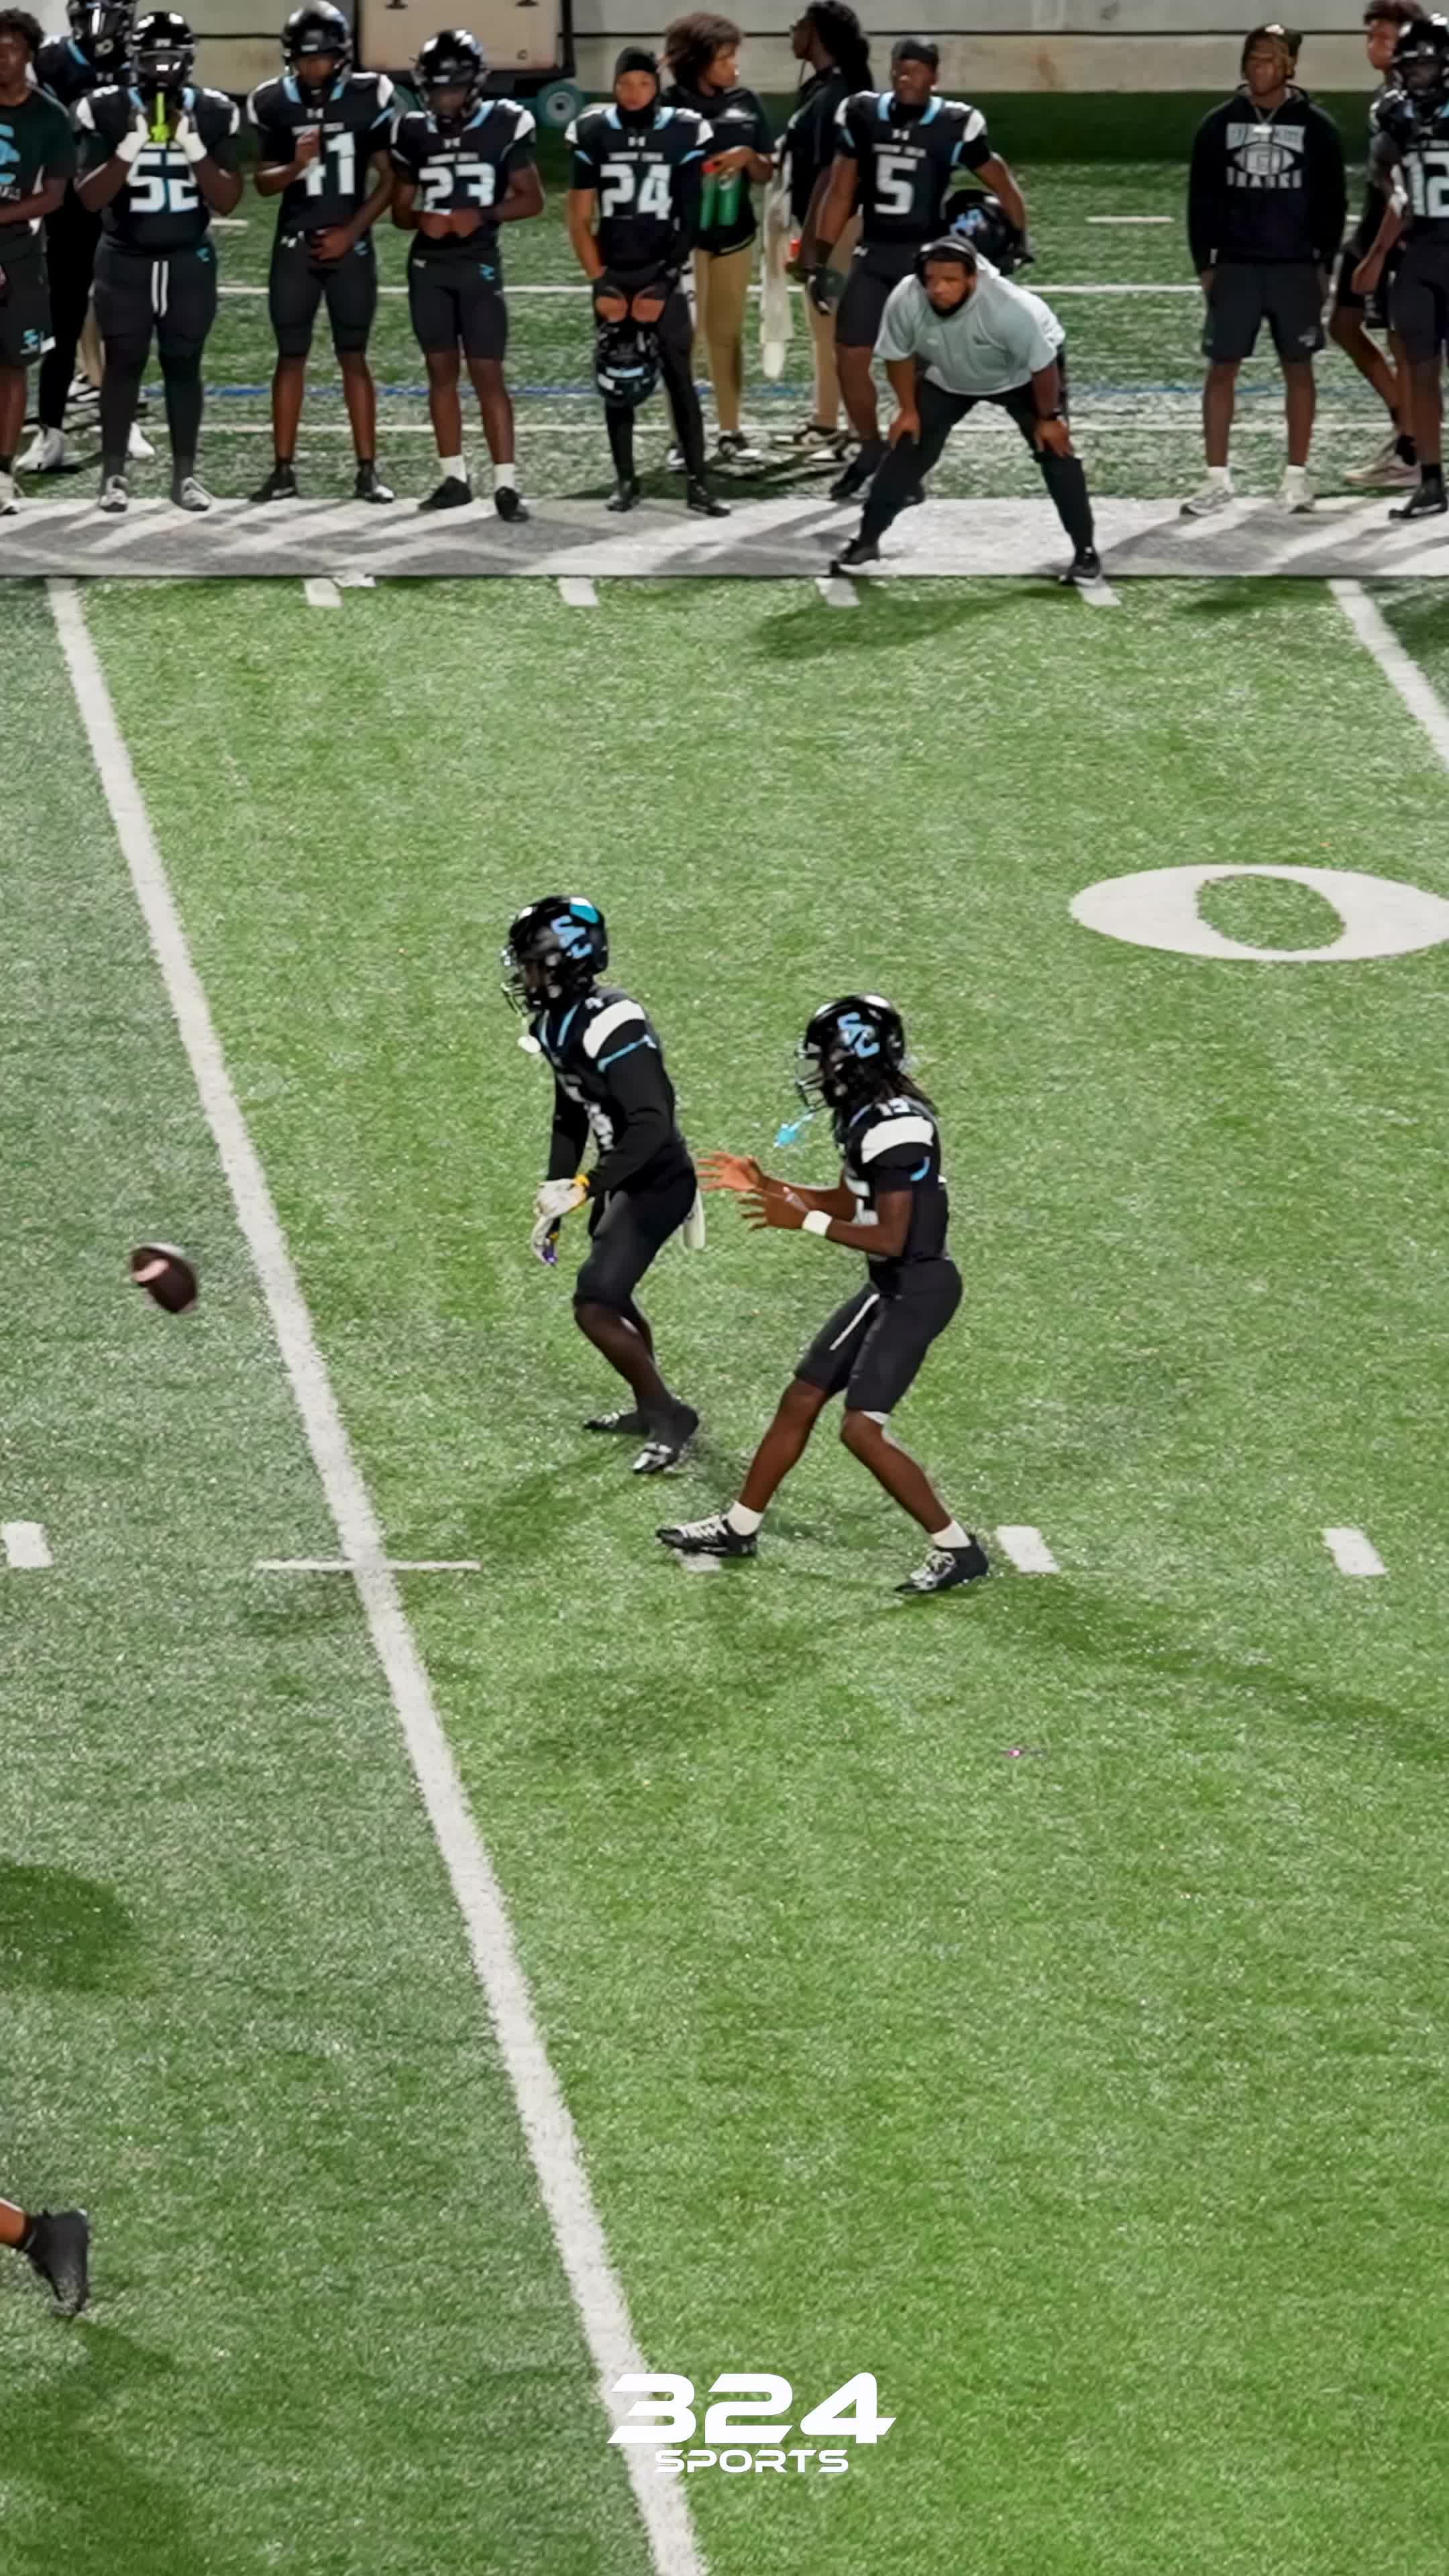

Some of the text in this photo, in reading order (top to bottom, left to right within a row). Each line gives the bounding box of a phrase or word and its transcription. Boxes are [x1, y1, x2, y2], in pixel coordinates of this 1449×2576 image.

[126, 152, 199, 213] 52
[419, 162, 496, 215] 23
[600, 163, 673, 220] 24
[874, 154, 917, 214] 5
[1402, 150, 1449, 217] 12
